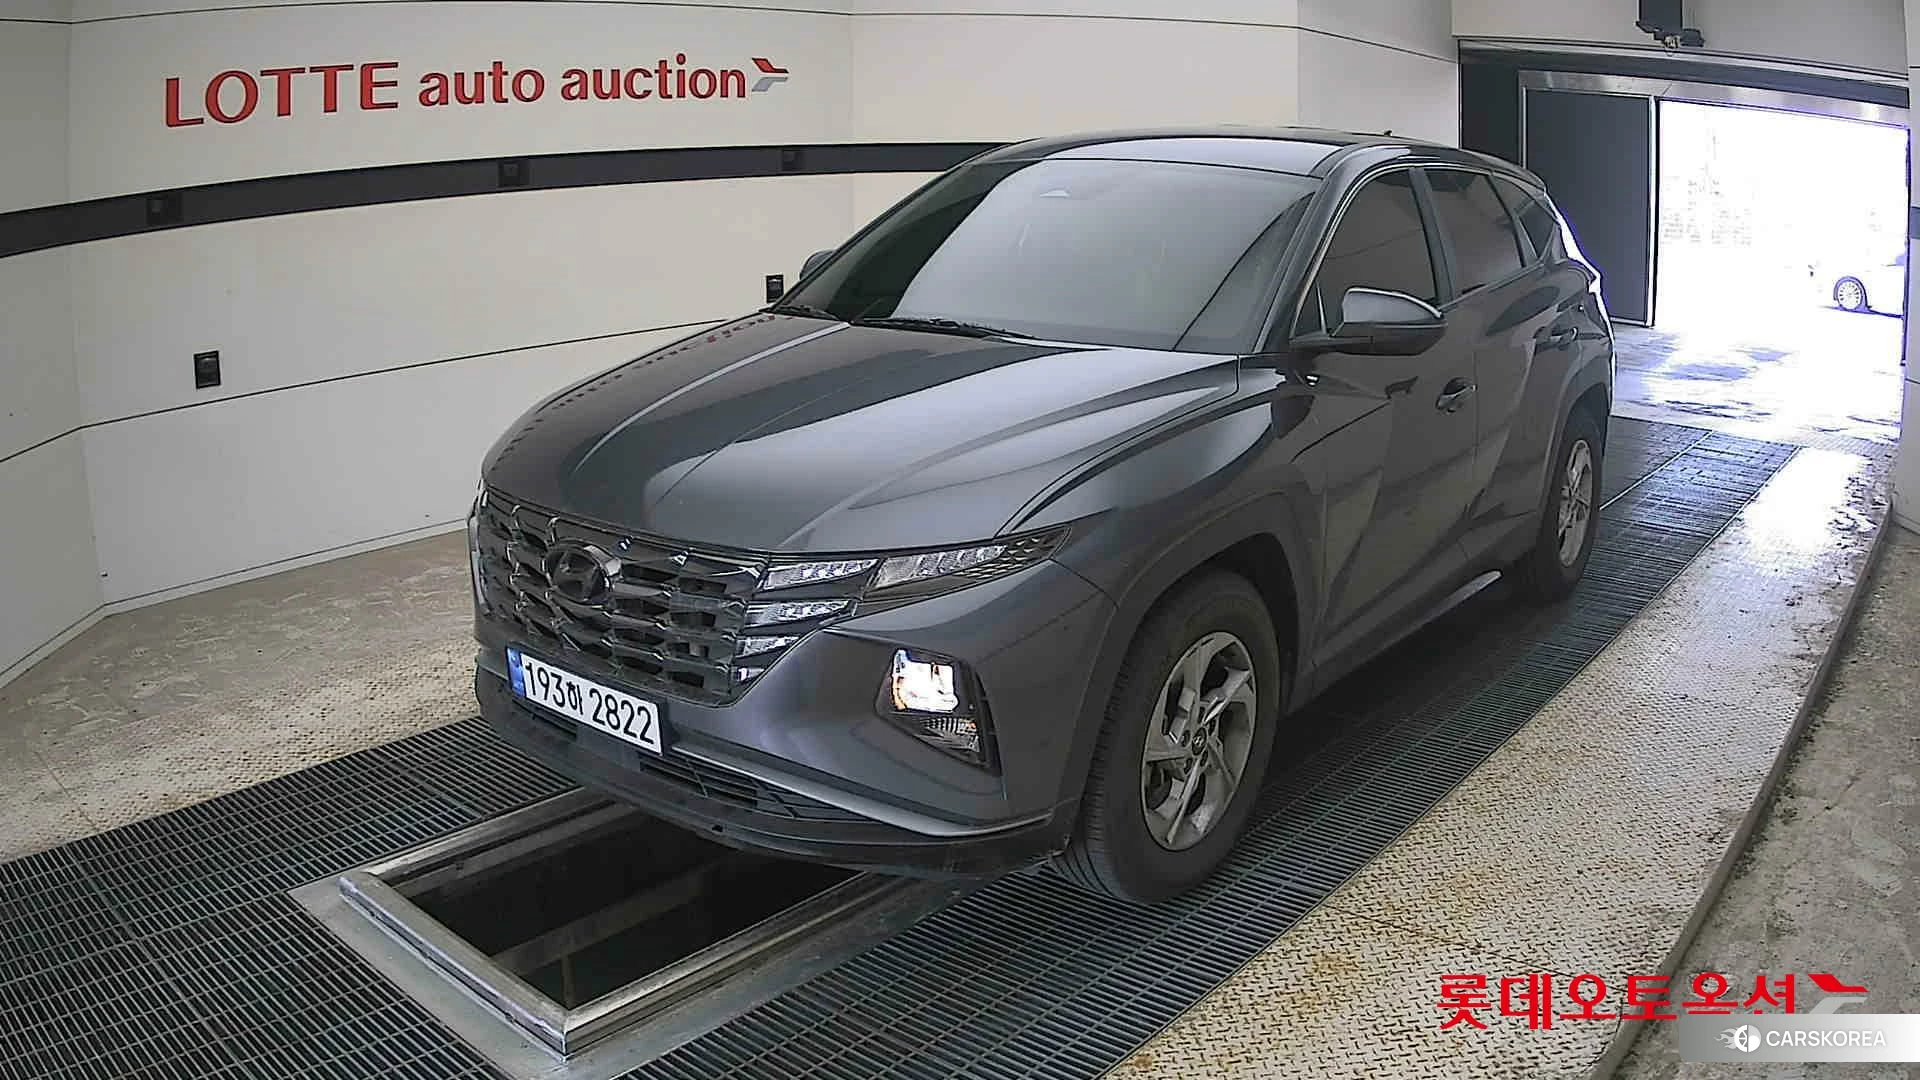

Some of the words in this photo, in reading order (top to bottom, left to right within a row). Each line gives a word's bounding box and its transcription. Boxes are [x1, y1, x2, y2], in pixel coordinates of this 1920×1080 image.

[165, 61, 399, 128] LOTTE
[417, 61, 546, 107] auto
[560, 53, 747, 101] auction
[525, 662, 584, 717] 193하
[589, 687, 655, 745] 2822
